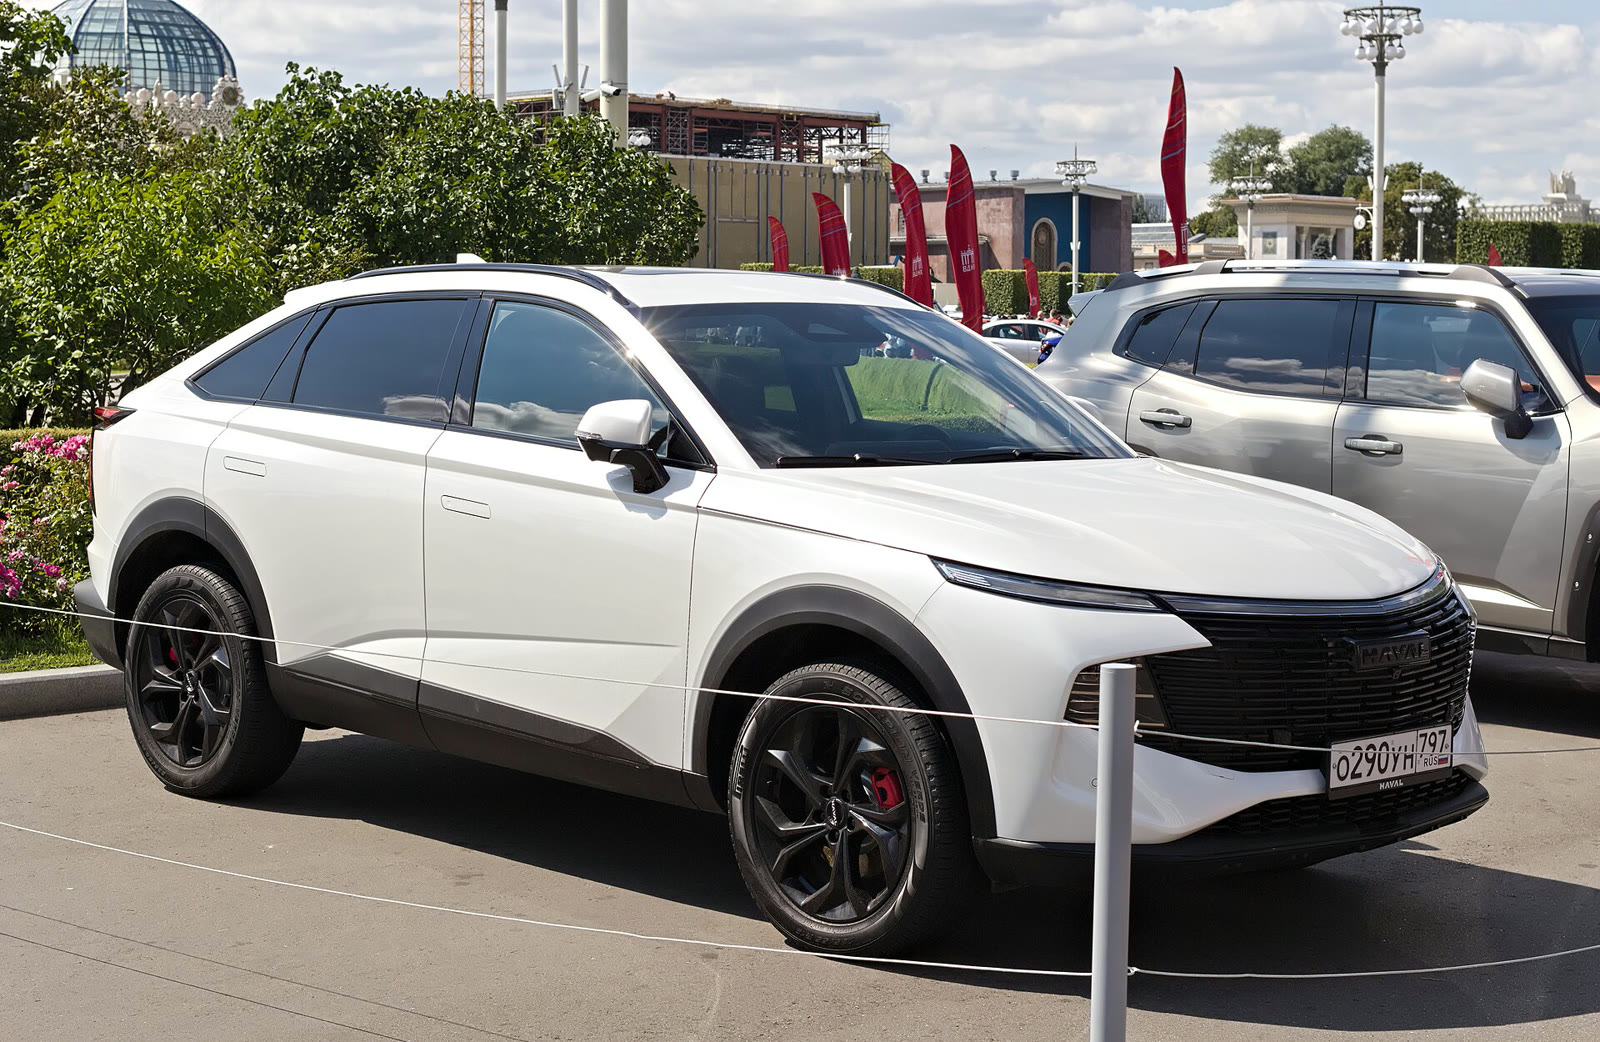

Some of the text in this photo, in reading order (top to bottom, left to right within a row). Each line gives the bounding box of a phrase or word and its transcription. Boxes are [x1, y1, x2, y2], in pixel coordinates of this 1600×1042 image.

[1362, 642, 1429, 664] HAVAL
[1419, 729, 1447, 758] 797
[1423, 756, 1438, 767] RUS
[1379, 779, 1404, 790] HAVAL
